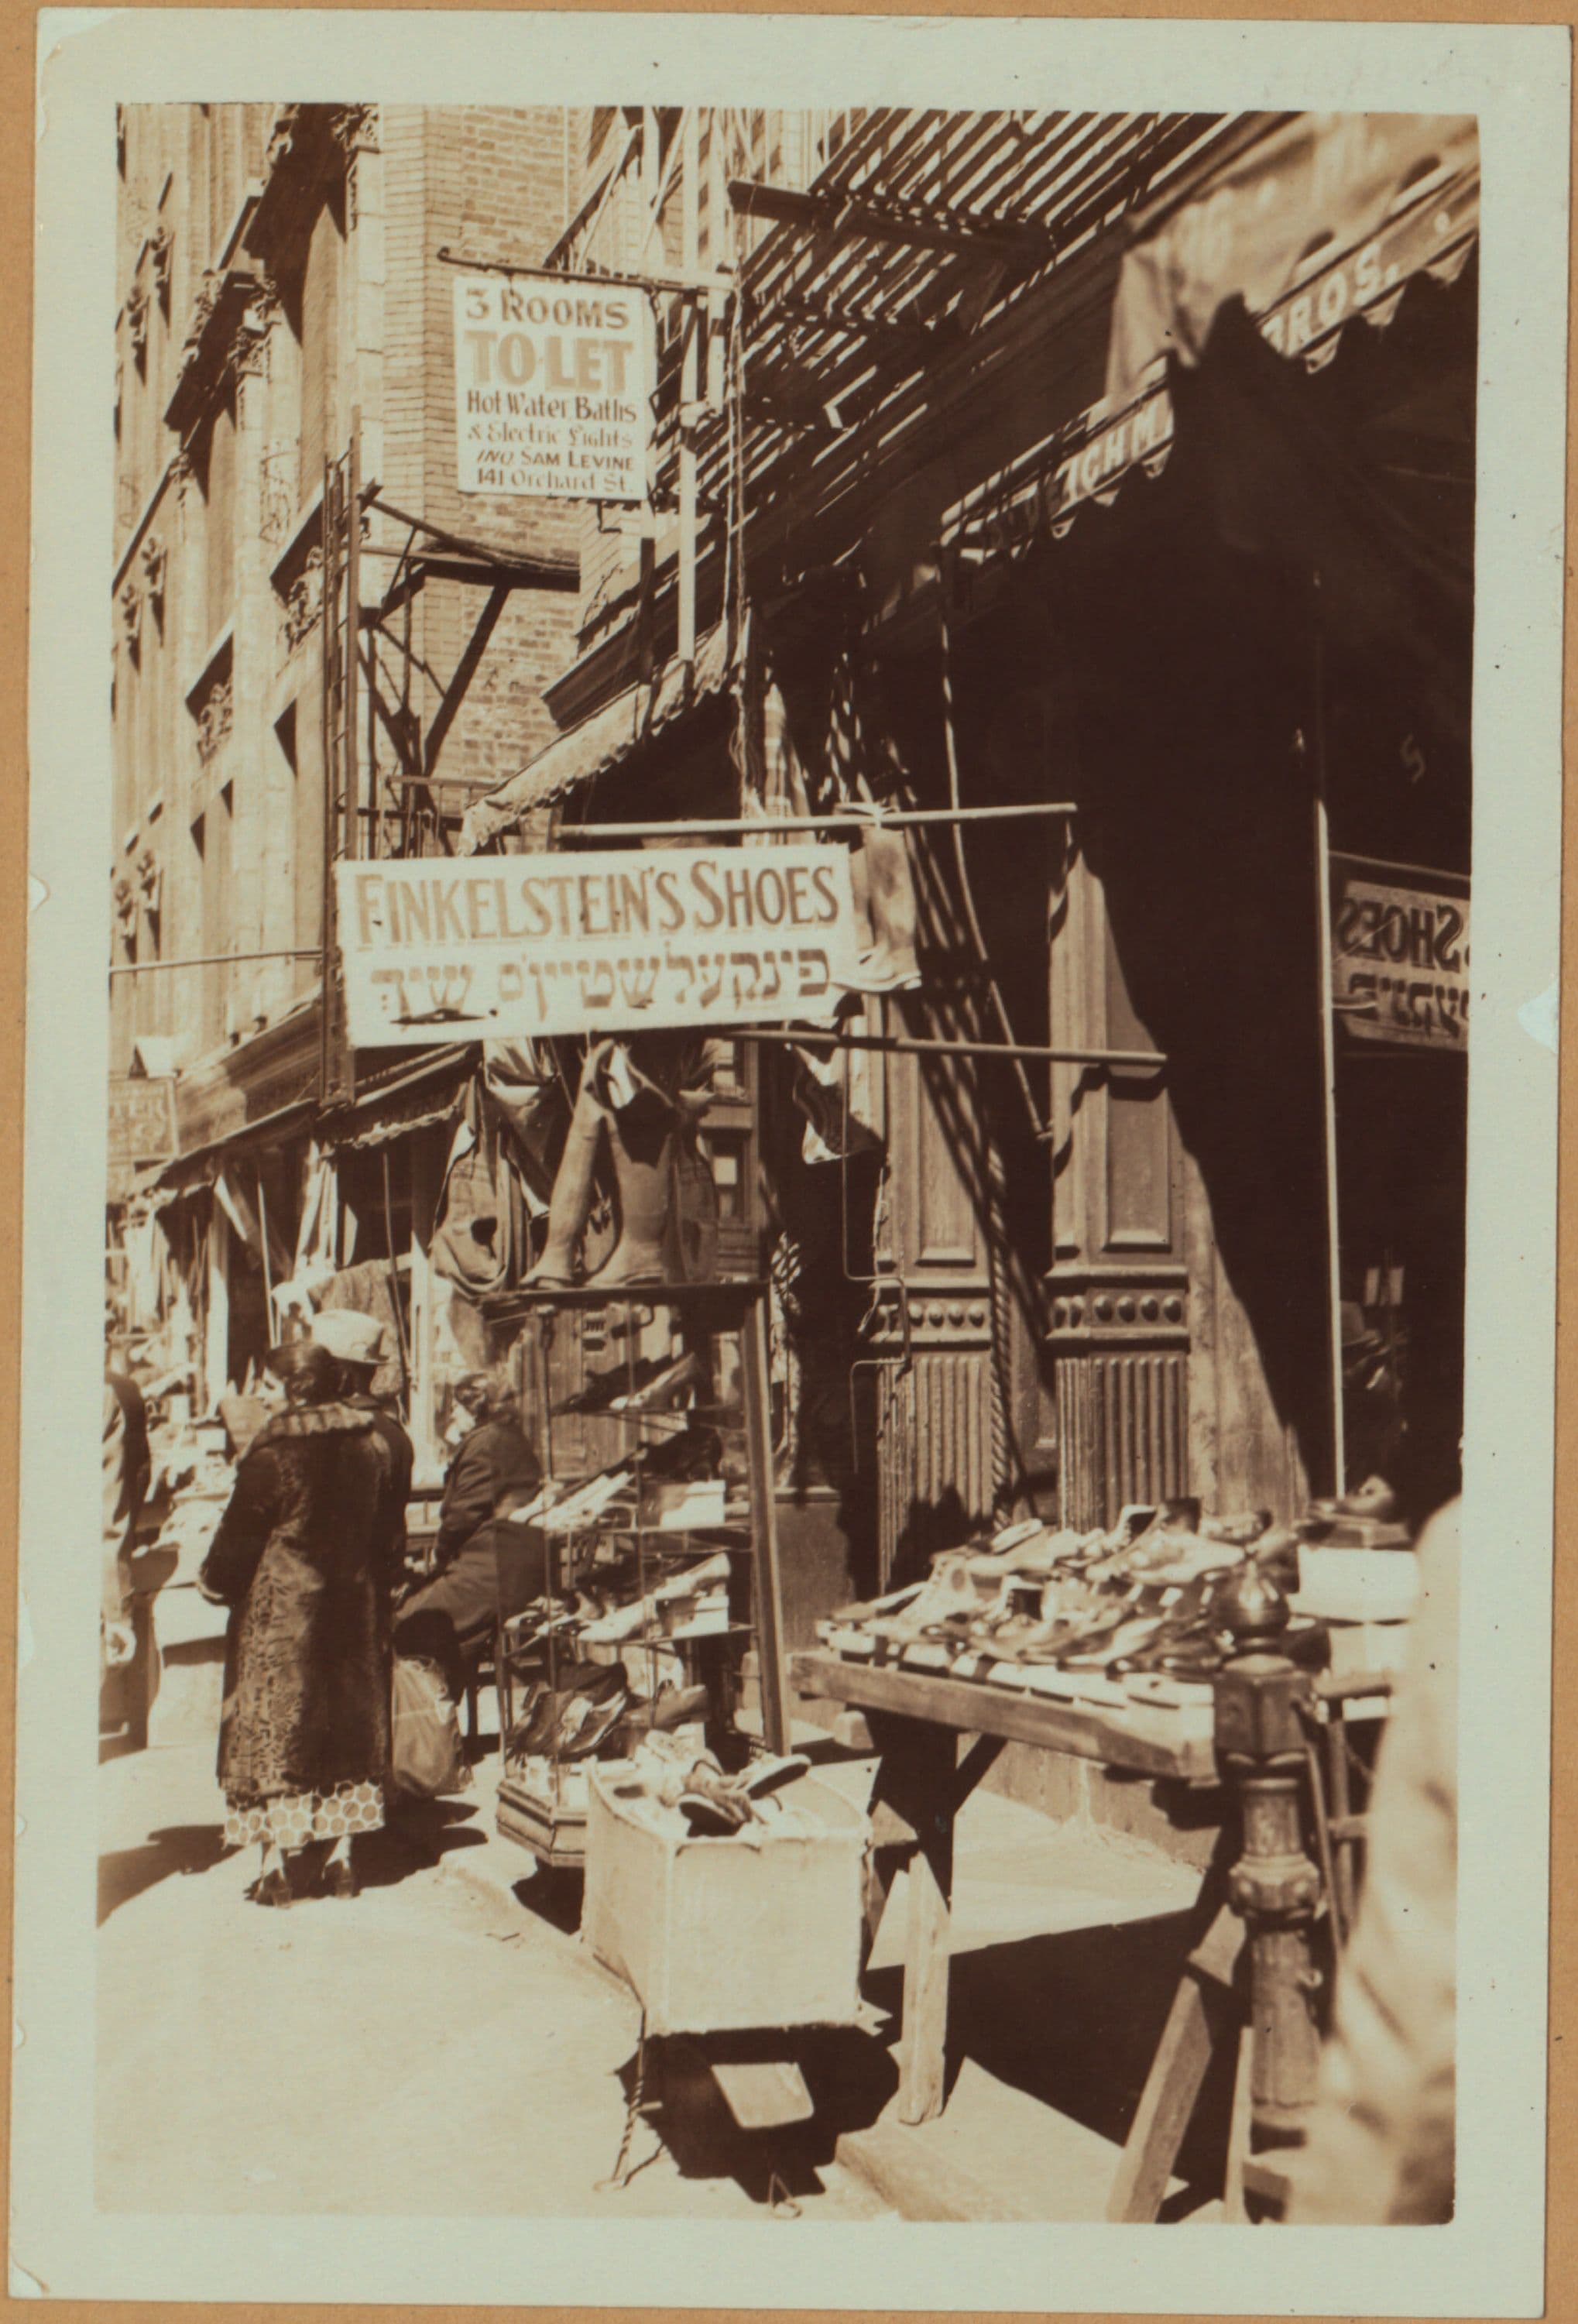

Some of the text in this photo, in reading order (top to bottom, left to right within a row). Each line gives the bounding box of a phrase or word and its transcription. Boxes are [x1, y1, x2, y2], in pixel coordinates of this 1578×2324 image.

[466, 287, 629, 330] 3 ROOMS
[544, 335, 633, 396] LET
[467, 390, 637, 423] Hot Water Baths
[468, 422, 633, 450] & Electric Lights
[520, 447, 561, 467] SAM
[568, 450, 633, 472] LEVINE
[477, 468, 634, 493] 141 Orchard St.
[355, 860, 839, 946] FINKELSTEIN'S SHOES
